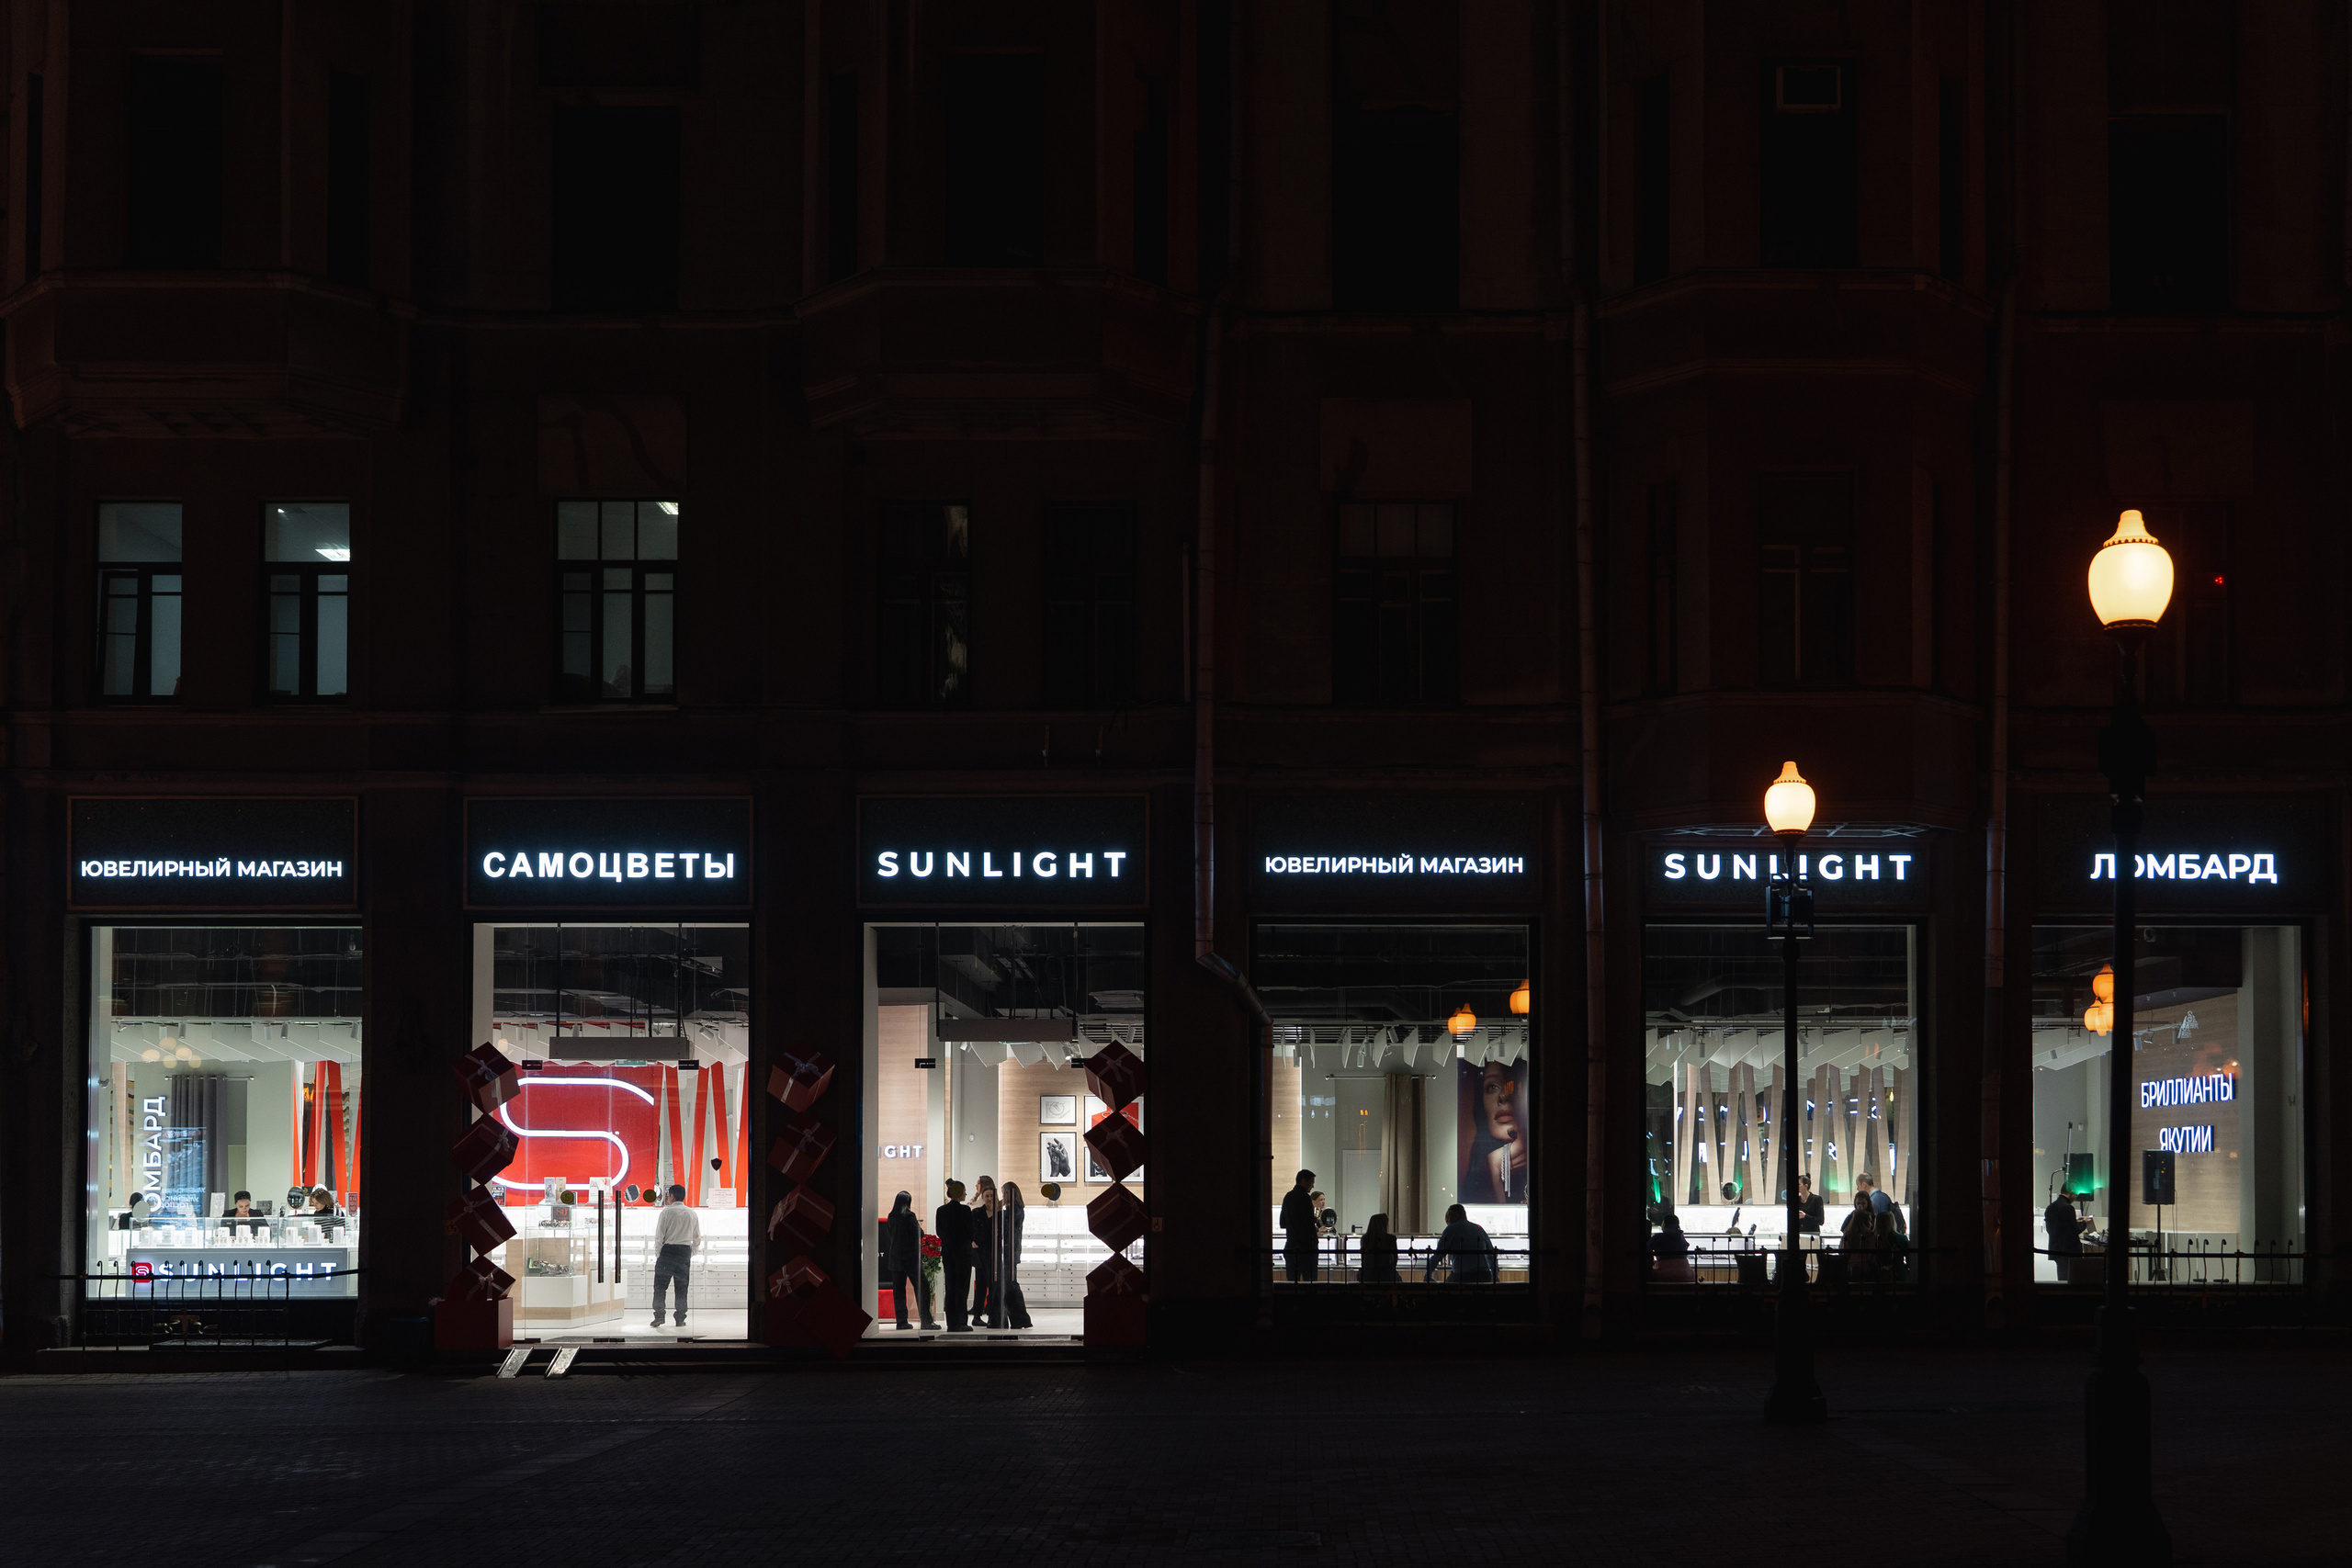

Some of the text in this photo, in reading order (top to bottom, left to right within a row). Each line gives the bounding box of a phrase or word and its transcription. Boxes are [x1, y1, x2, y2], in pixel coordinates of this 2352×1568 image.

[81, 858, 343, 877] ЮВЕЛИРНЫЙ МАГАЗИН
[483, 852, 735, 883] САМОЦВЕТЫ
[877, 852, 1126, 878] SUNLIGHT
[1265, 853, 1523, 874] ЮВЕЛИРНЫЙ МАГАЗИН
[2141, 1072, 2233, 1108] БРИЛЛИАНТЫ
[2159, 1125, 2212, 1154] ЯКУТИИ
[143, 1096, 166, 1213] ОМБАРД
[158, 1262, 337, 1282] SUNLIGHT
